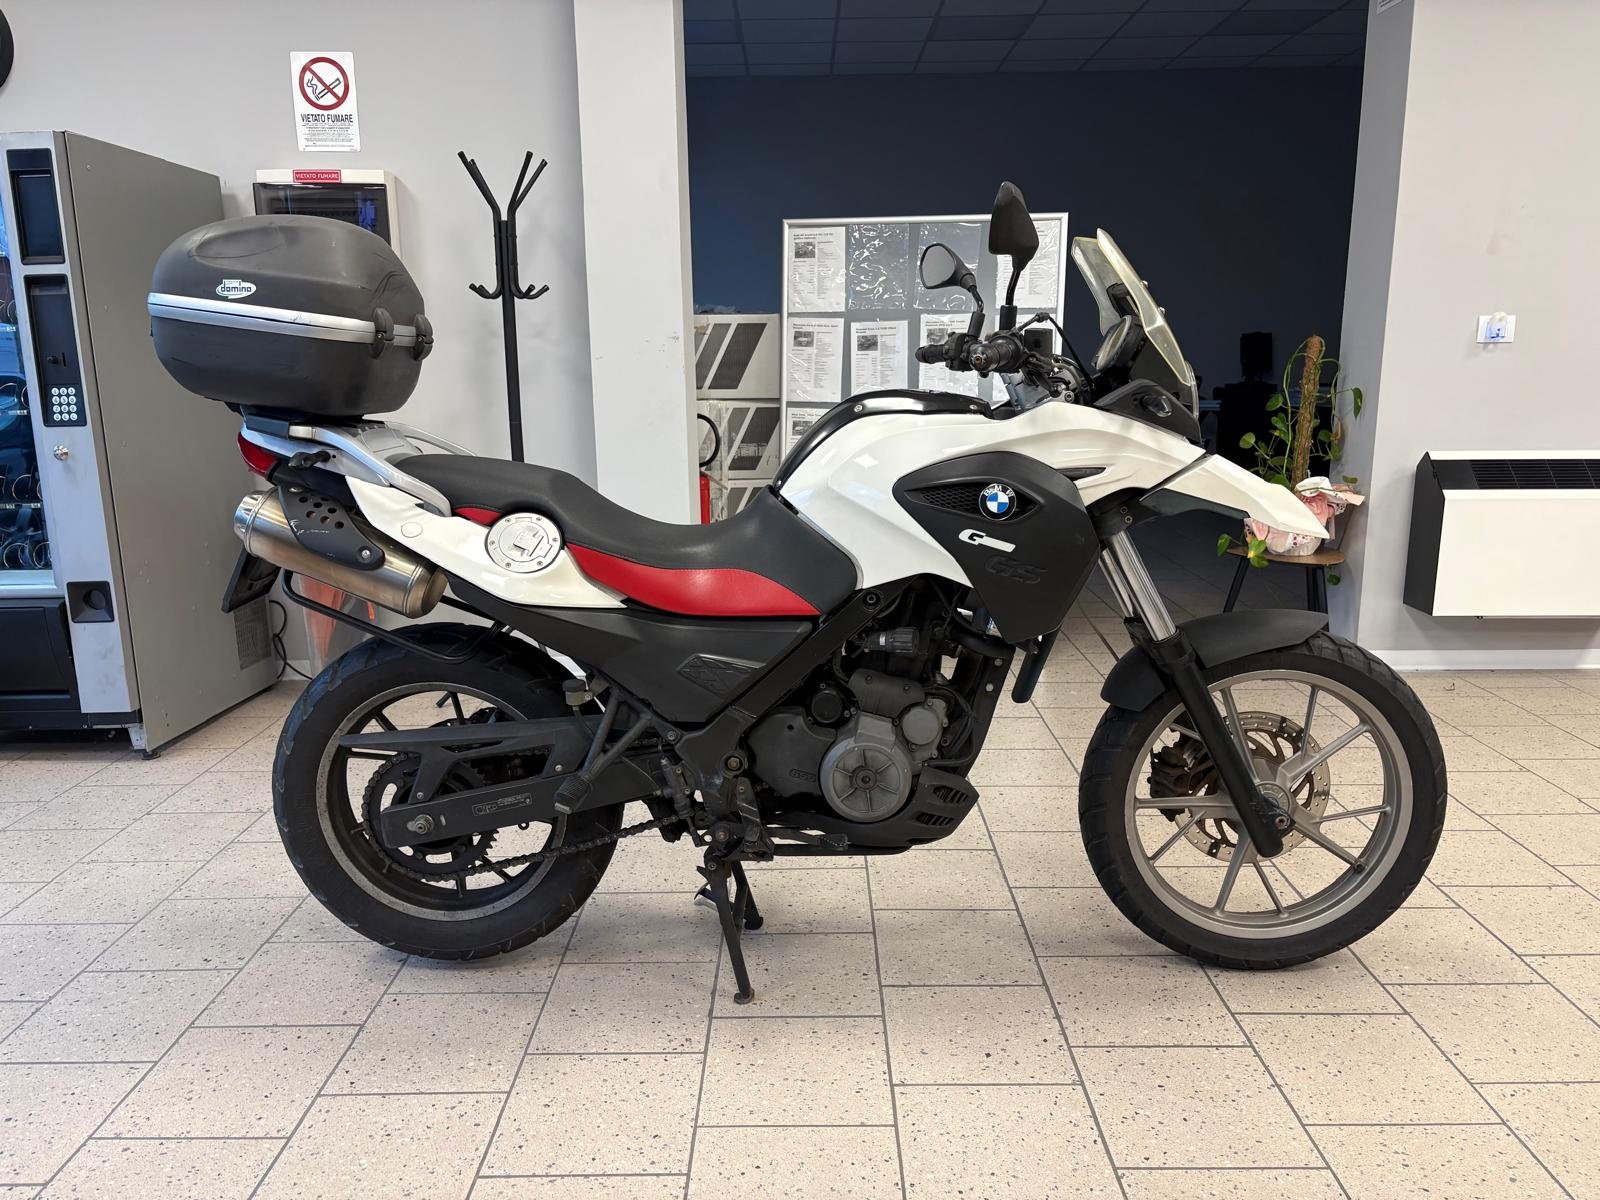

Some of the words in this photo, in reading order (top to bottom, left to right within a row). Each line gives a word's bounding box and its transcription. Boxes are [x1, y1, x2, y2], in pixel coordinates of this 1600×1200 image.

[300, 113, 326, 123] VIETATO
[327, 113, 354, 123] FUMARE
[983, 484, 1015, 498] BMW
